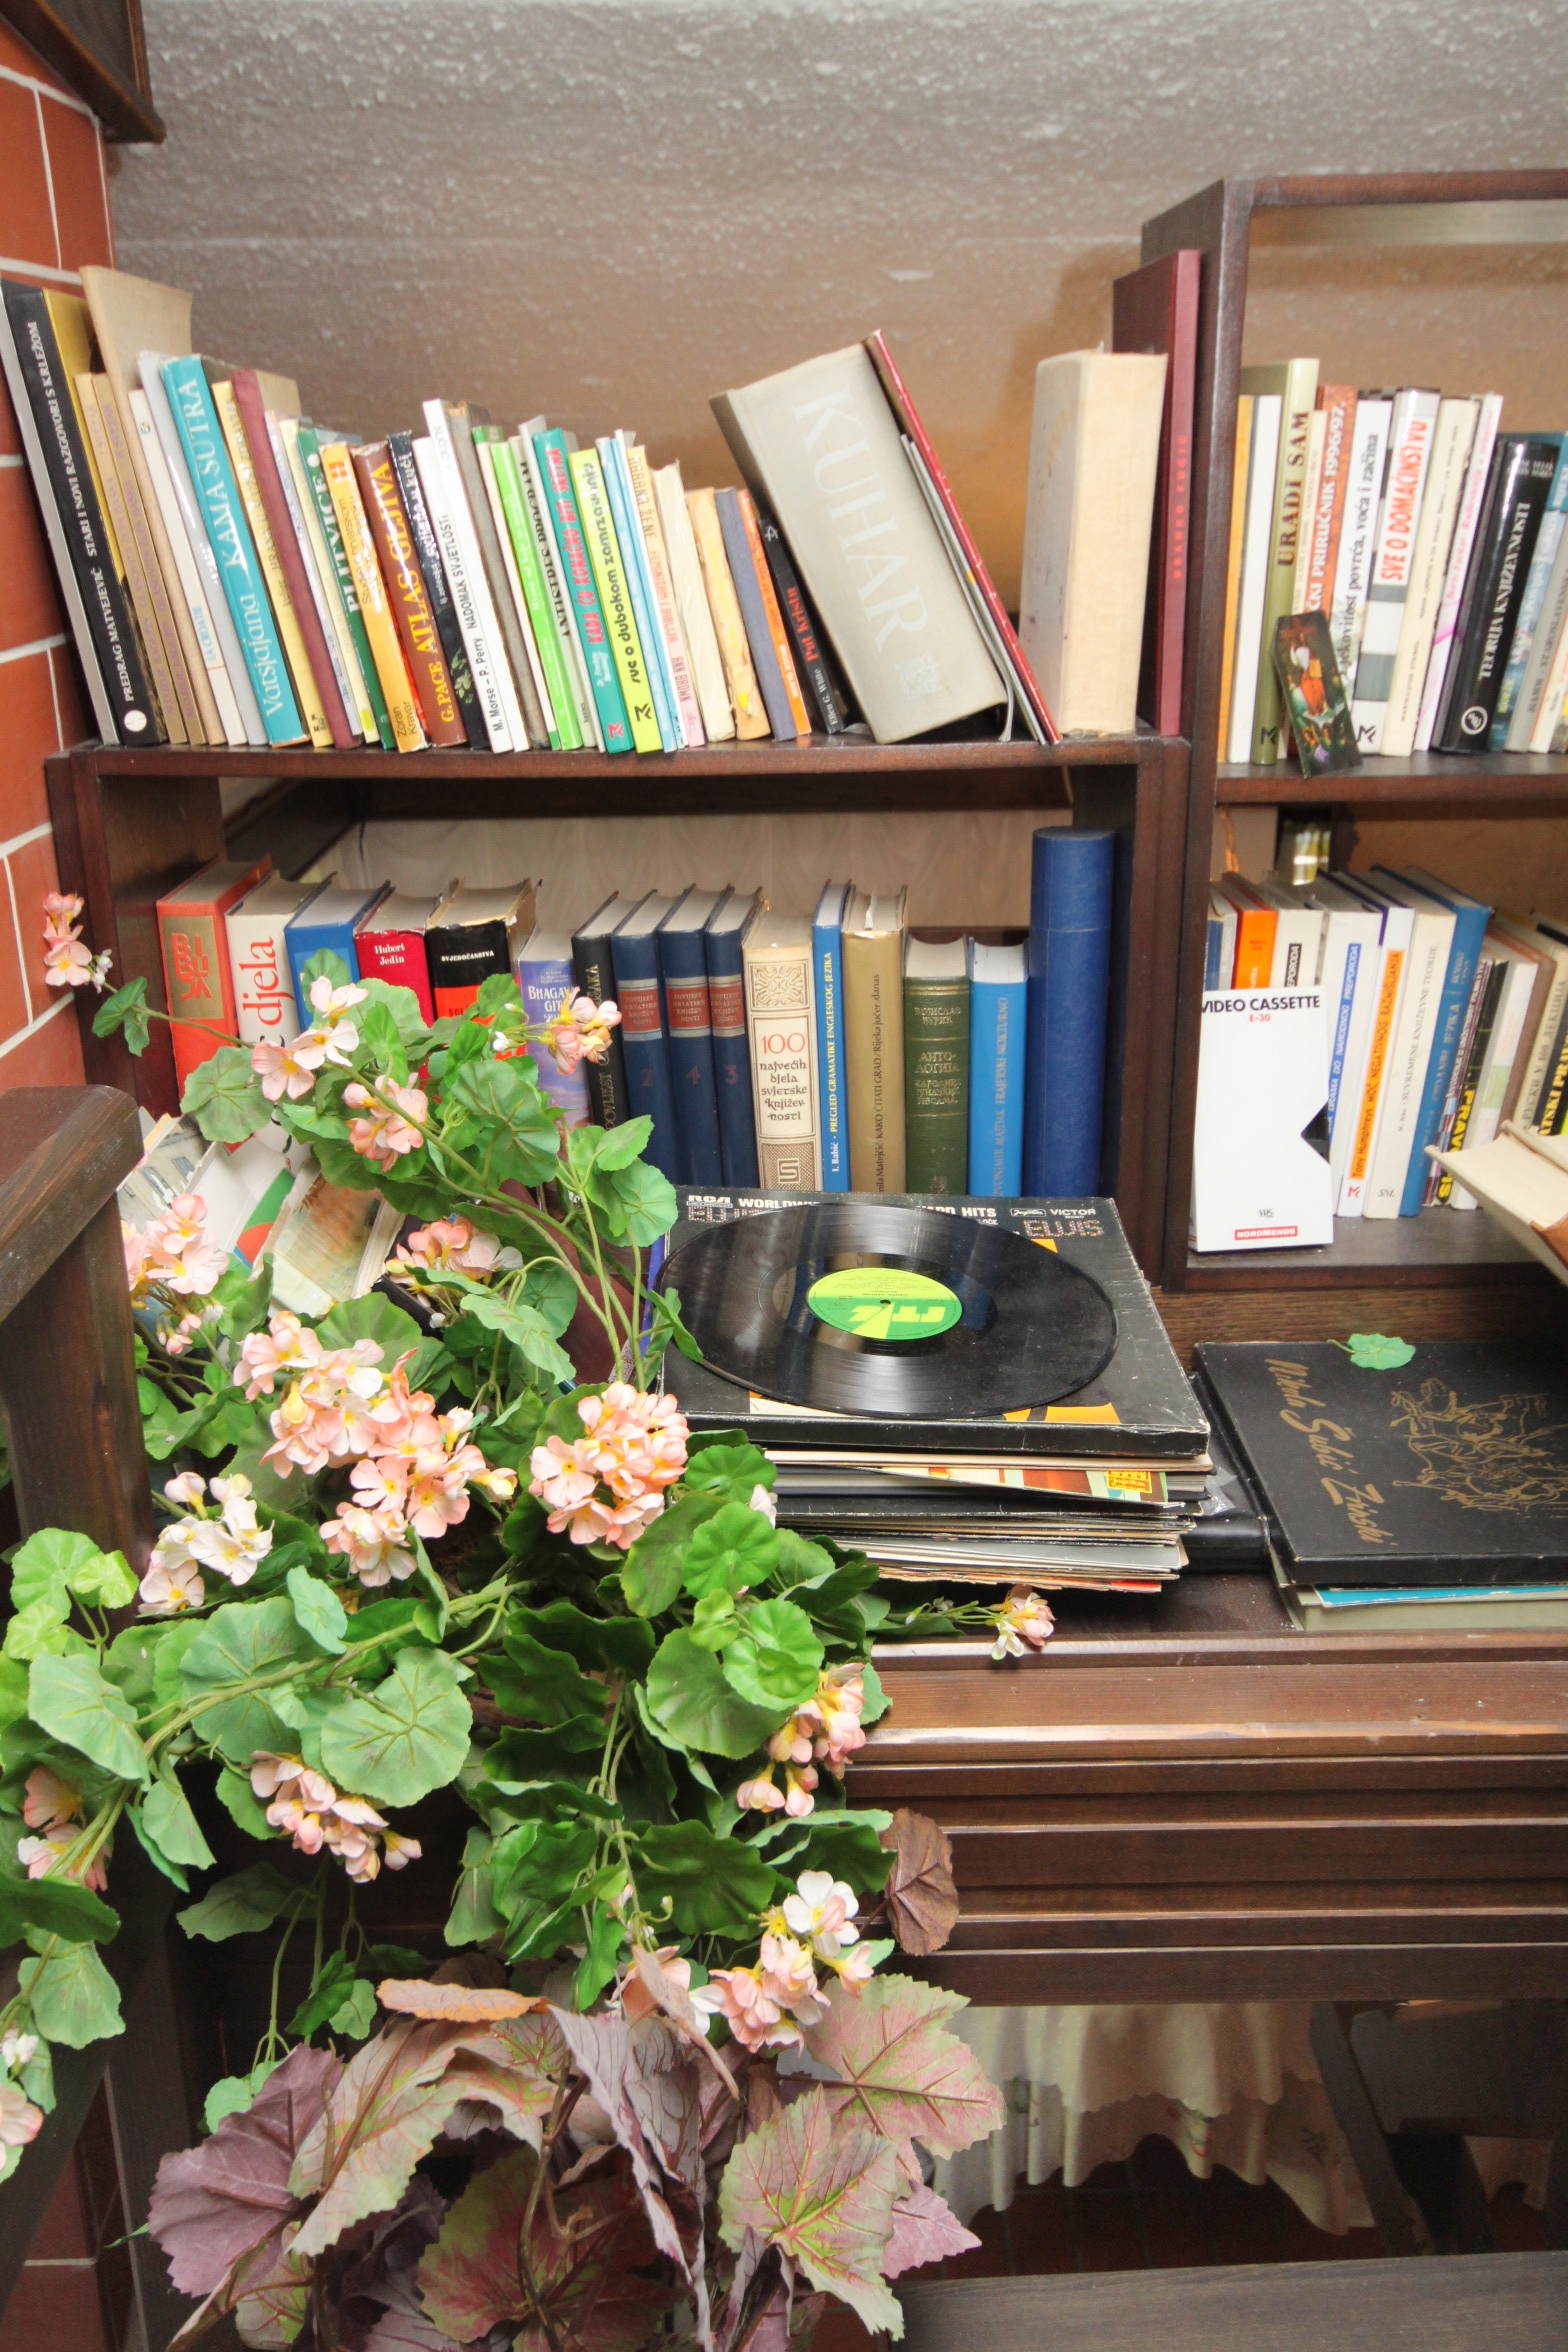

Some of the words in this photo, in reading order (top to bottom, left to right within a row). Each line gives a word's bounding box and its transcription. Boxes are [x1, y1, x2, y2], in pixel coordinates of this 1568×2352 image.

[25, 320, 53, 388] KRLEŽOM
[45, 389, 56, 397] S
[47, 397, 76, 475] RAZGOVORI
[175, 377, 220, 476] SUTRA
[1287, 409, 1310, 467] SAM
[397, 451, 420, 487] kući
[544, 446, 570, 494] SRETNA
[1359, 433, 1378, 481] začina
[68, 476, 85, 510] NOVI
[203, 476, 245, 568] KAMA
[337, 496, 360, 556] hrvatskom
[367, 460, 413, 563] GLJIVA
[556, 498, 577, 524] BITI
[639, 508, 660, 539] ŽENE
[792, 387, 928, 653] KUHAR
[1276, 478, 1303, 567] URADI
[1352, 496, 1369, 529] voća
[78, 517, 97, 557] STARI
[312, 474, 360, 614] PLITVICE
[1310, 480, 1336, 577] PRIRUČNIK
[1386, 537, 1409, 551] O
[561, 526, 592, 586] KONAČNO
[1346, 534, 1367, 590] povrća,
[1380, 552, 1406, 581] SVE
[649, 549, 668, 599] FEMINIZAM
[1477, 615, 1505, 681] TEORIJA
[1491, 500, 1530, 614] KNJIŽEVNOSTI
[89, 565, 120, 643] MATVEJEVIĆ
[396, 568, 438, 657] ATLAS
[454, 579, 477, 629] NADOMAK
[576, 588, 595, 607] ĆU
[603, 568, 632, 642] dubokom
[783, 585, 810, 634] Kristu
[583, 611, 604, 645] KADA
[661, 607, 677, 642] BIBLIJA
[470, 636, 488, 664] Perry
[624, 645, 635, 656] o
[671, 656, 685, 673] ANN
[800, 635, 819, 662] Put
[111, 643, 135, 701] PREDRAG
[477, 665, 489, 676] P.
[625, 659, 641, 684] sve
[779, 643, 791, 670] BRUCE
[786, 670, 799, 697] OLSON
[812, 667, 827, 692] White
[483, 687, 500, 717] Morse
[675, 674, 692, 701] BROWN
[821, 692, 831, 703] G.
[389, 705, 408, 738] Zoran
[399, 699, 418, 735] Kravar
[491, 719, 503, 731] M.
[824, 703, 838, 725] Ellen
[374, 942, 405, 954] Hubert
[380, 955, 405, 966] Jedin
[441, 950, 494, 962] SVJEDOČANSTVA
[239, 936, 294, 1026] djela
[823, 952, 833, 981] JEZIKA
[1343, 945, 1359, 999] PREPORODA
[1378, 949, 1400, 1015] RAZMIŠLJANJA
[674, 992, 703, 1000] POVIJEST
[824, 984, 835, 1038] ENGLESKOG
[1201, 999, 1246, 1013] VIDEO
[1250, 996, 1320, 1011] CASSETTE
[872, 1004, 882, 1025] jučer
[995, 997, 1008, 1054] NOKTURNO
[1249, 1013, 1271, 1023] E-30
[1335, 1004, 1350, 1055] NARODNOG
[1400, 1040, 1419, 1101] SUVREMENE
[1411, 986, 1430, 1040] KNJIŽEVNE
[1423, 945, 1437, 984] TEORIJE
[761, 1033, 805, 1054] 100
[1369, 1020, 1388, 1078] NEGATIVNOG
[640, 1067, 653, 1087] 2
[688, 1065, 700, 1084] 4
[724, 1064, 738, 1084] 3
[759, 1059, 807, 1071] najvećih
[770, 1073, 798, 1085] djela
[827, 1041, 837, 1091] GRAMATIKE
[995, 1057, 1008, 1104] FRAJERSKI
[1332, 1059, 1342, 1074] DO
[761, 1085, 808, 1096] svjetske
[873, 1084, 882, 1111] ČITATI
[1326, 1077, 1340, 1111] DRAMA
[1364, 1082, 1377, 1102] MOĆ
[829, 1093, 838, 1132] PREGLED
[875, 1114, 883, 1138] KAKO
[1356, 1107, 1374, 1155] Humphreys
[830, 1141, 839, 1163] Babić
[874, 1142, 885, 1176] Matejčić
[1352, 1157, 1365, 1177] Tony
[688, 1195, 731, 1203] RCA
[961, 1207, 997, 1217] HITS
[1050, 1208, 1096, 1216] VICTOR
[1259, 1209, 1274, 1218] VHS
[1236, 1227, 1296, 1238] NORDMENDE
[1264, 1358, 1326, 1408] Nikola
[1321, 1477, 1398, 1546] Zrinski
